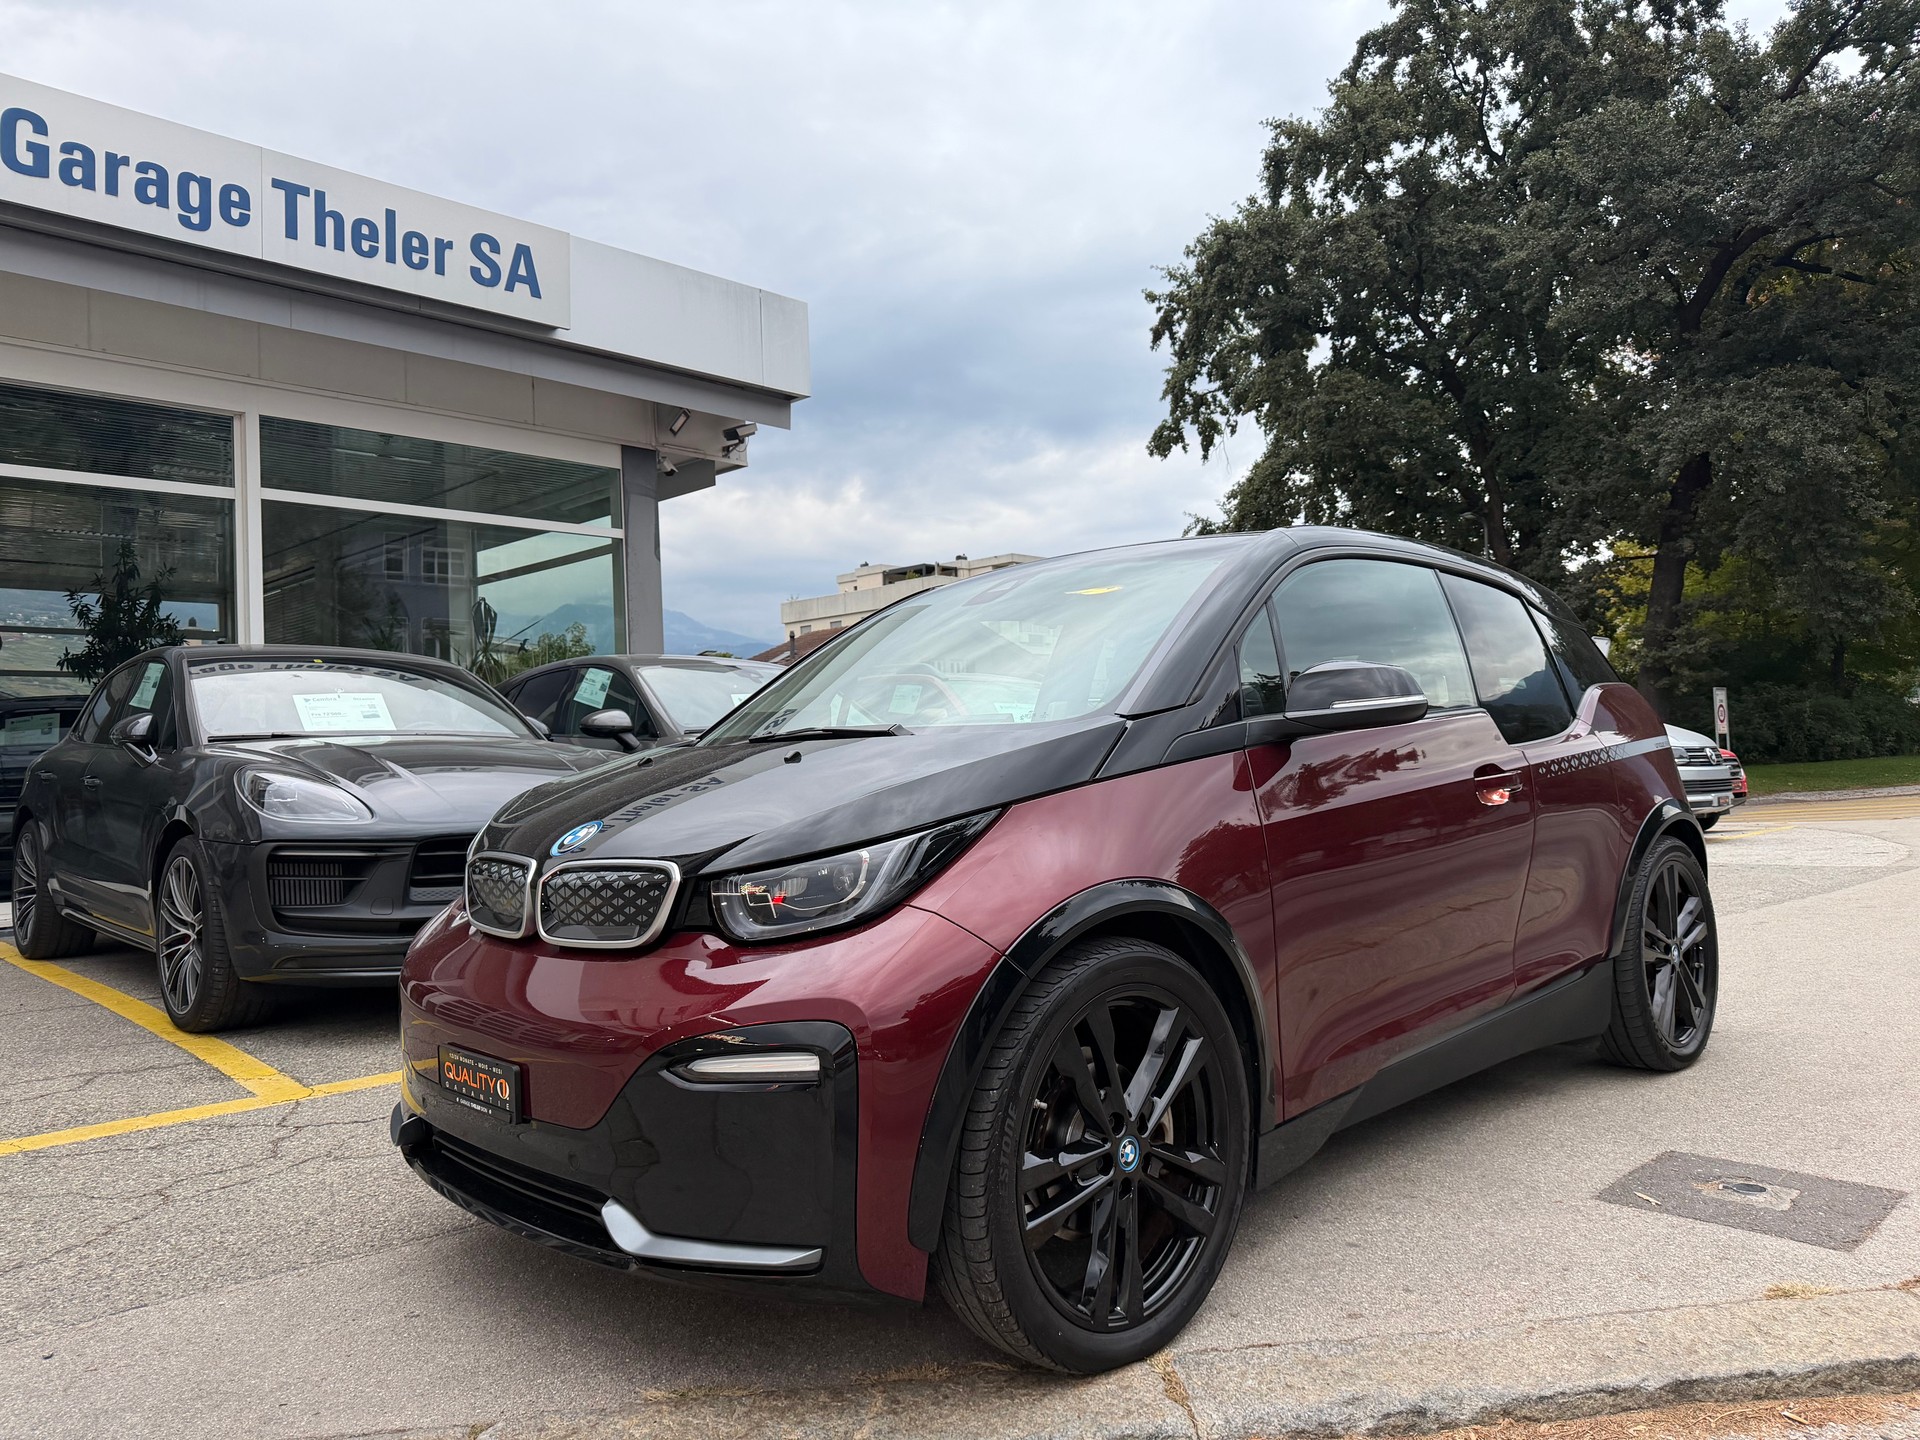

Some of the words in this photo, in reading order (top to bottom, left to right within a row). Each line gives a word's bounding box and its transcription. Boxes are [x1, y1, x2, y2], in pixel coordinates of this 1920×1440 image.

[0, 107, 251, 232] Garage
[271, 178, 453, 276] Theler
[469, 232, 542, 300] SA
[444, 1061, 496, 1094] QUALITY
[445, 1081, 510, 1111] GARANTIE
